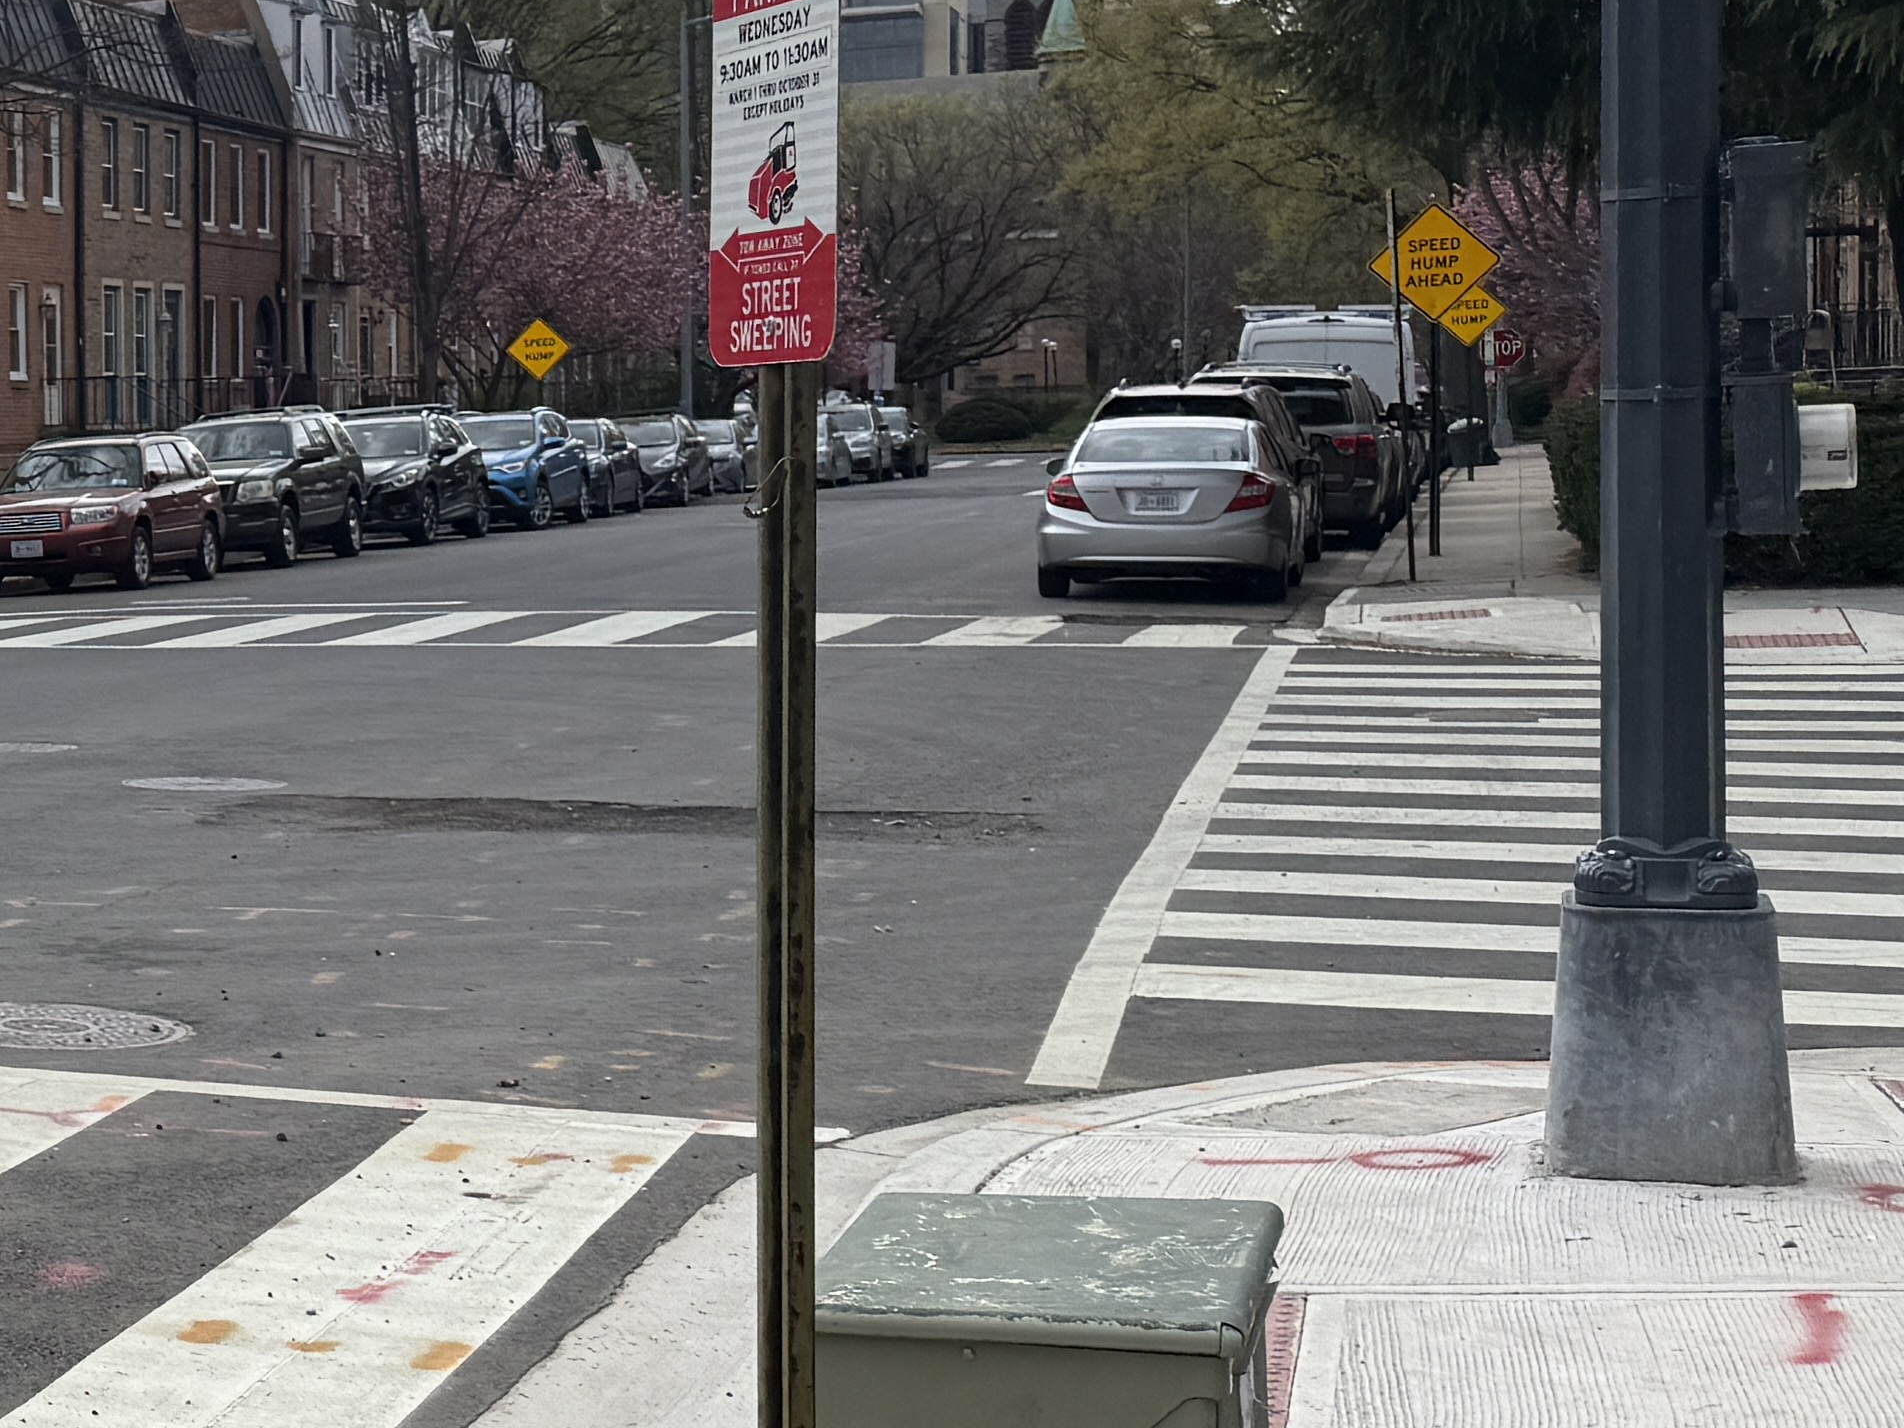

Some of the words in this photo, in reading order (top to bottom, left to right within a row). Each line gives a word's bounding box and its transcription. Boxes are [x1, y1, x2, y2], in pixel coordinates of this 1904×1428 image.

[738, 4, 812, 45] WEDNESDAY
[720, 54, 762, 85] 9:30AM
[765, 51, 780, 73] TO
[1408, 237, 1461, 253] SPEED
[1410, 255, 1459, 271] HUMP
[1405, 272, 1464, 288] AHEAD
[742, 276, 801, 316] STREET
[1451, 315, 1487, 325] HUMP
[730, 314, 812, 353] SWEEPING
[523, 337, 556, 348] SPEED
[1495, 340, 1522, 356] TOP
